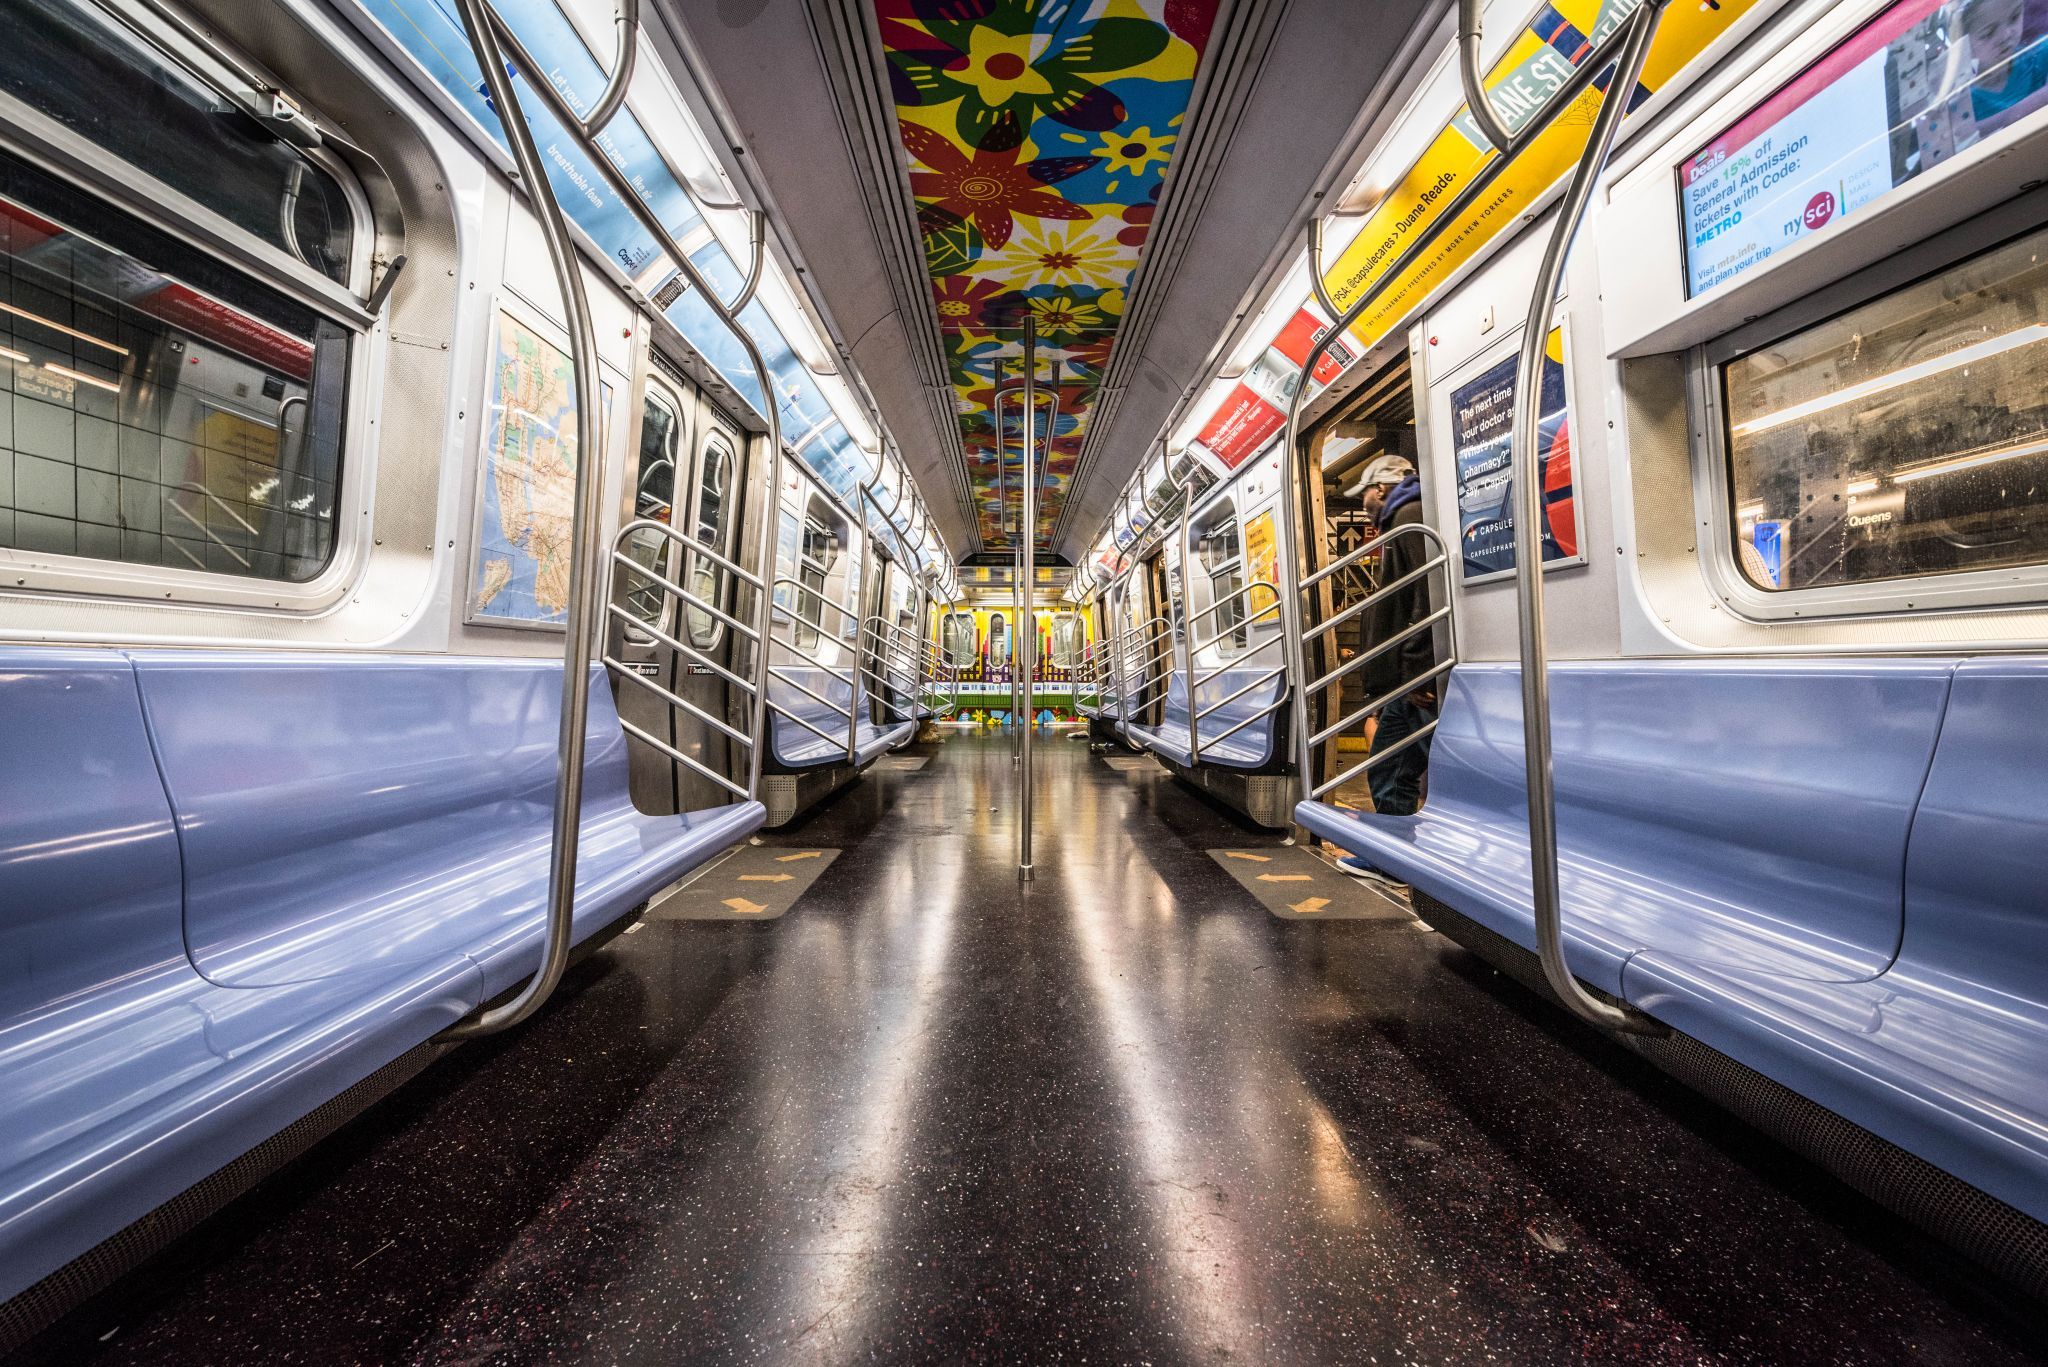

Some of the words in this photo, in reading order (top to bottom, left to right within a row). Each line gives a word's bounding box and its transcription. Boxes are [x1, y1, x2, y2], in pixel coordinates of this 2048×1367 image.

[1531, 53, 1570, 91] ST
[550, 67, 567, 86] Let
[561, 86, 585, 110] your
[608, 148, 628, 169] pass
[546, 144, 588, 191] breathable
[584, 187, 604, 209] foam
[632, 175, 645, 191] like
[1689, 150, 1725, 182] Deals
[1692, 177, 1719, 202] Save
[1722, 157, 1750, 181] 15%
[1755, 138, 1773, 159] off
[1693, 183, 1736, 217] General
[1740, 135, 1808, 187] Admission
[1848, 161, 1880, 183] DESIGN
[1694, 205, 1730, 233] tickets
[1733, 187, 1758, 207] with
[1762, 160, 1800, 189] Code:
[1848, 180, 1872, 196] MAKE
[1347, 237, 1396, 289] @capsulecares
[1396, 203, 1425, 234] Duane
[1420, 172, 1457, 205] Reade.
[1696, 211, 1742, 248] METRO
[618, 248, 638, 270] Casper
[1374, 311, 1383, 321] THE
[1383, 289, 1408, 312] PHARMACY
[1408, 262, 1437, 288] PREFERRED
[1436, 252, 1445, 262] BY
[1445, 235, 1464, 253] MORE
[1464, 219, 1480, 236] NEW
[1480, 188, 1514, 220] YORKERS
[1698, 265, 1715, 280] Visit
[1717, 242, 1757, 271] mta.info
[1699, 276, 1714, 292] and
[1715, 269, 1733, 285] plan
[1734, 258, 1755, 276] your
[1756, 247, 1772, 262] trip
[1460, 409, 1475, 422] The
[1475, 397, 1492, 413] next
[1493, 386, 1512, 404] time
[1461, 426, 1479, 443] your
[1480, 411, 1505, 432] doctor
[1489, 432, 1508, 450] your
[1466, 486, 1480, 498] say,
[1480, 469, 1511, 491] “Capsul
[1480, 518, 1513, 535] CAPSULE
[1849, 512, 1892, 528] Queens
